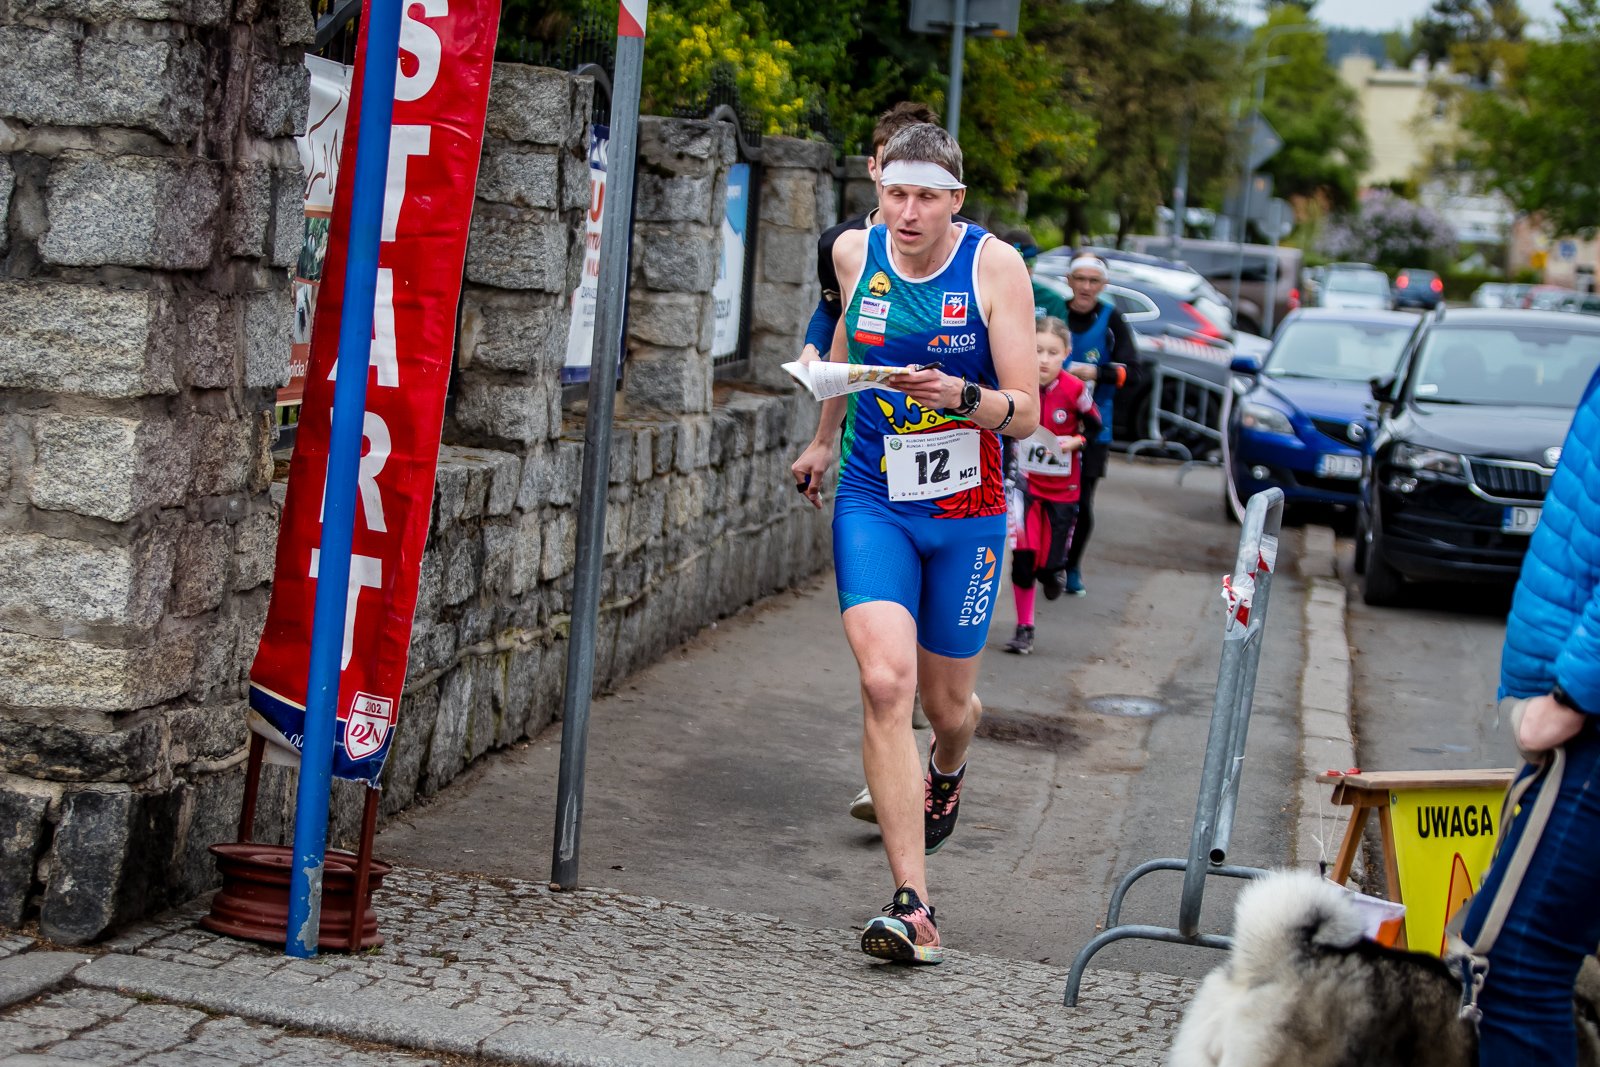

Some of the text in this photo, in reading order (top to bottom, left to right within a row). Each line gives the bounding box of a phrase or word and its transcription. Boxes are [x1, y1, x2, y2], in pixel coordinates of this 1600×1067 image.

[309, 0, 448, 672] START
[944, 345, 976, 354] SZCZECIN
[950, 333, 976, 347] KOS
[915, 448, 951, 485] 12
[959, 466, 977, 480] M21
[958, 546, 986, 626] BnO SZCZECIN
[971, 580, 993, 625] KOS
[1417, 805, 1494, 838] UWAGA
